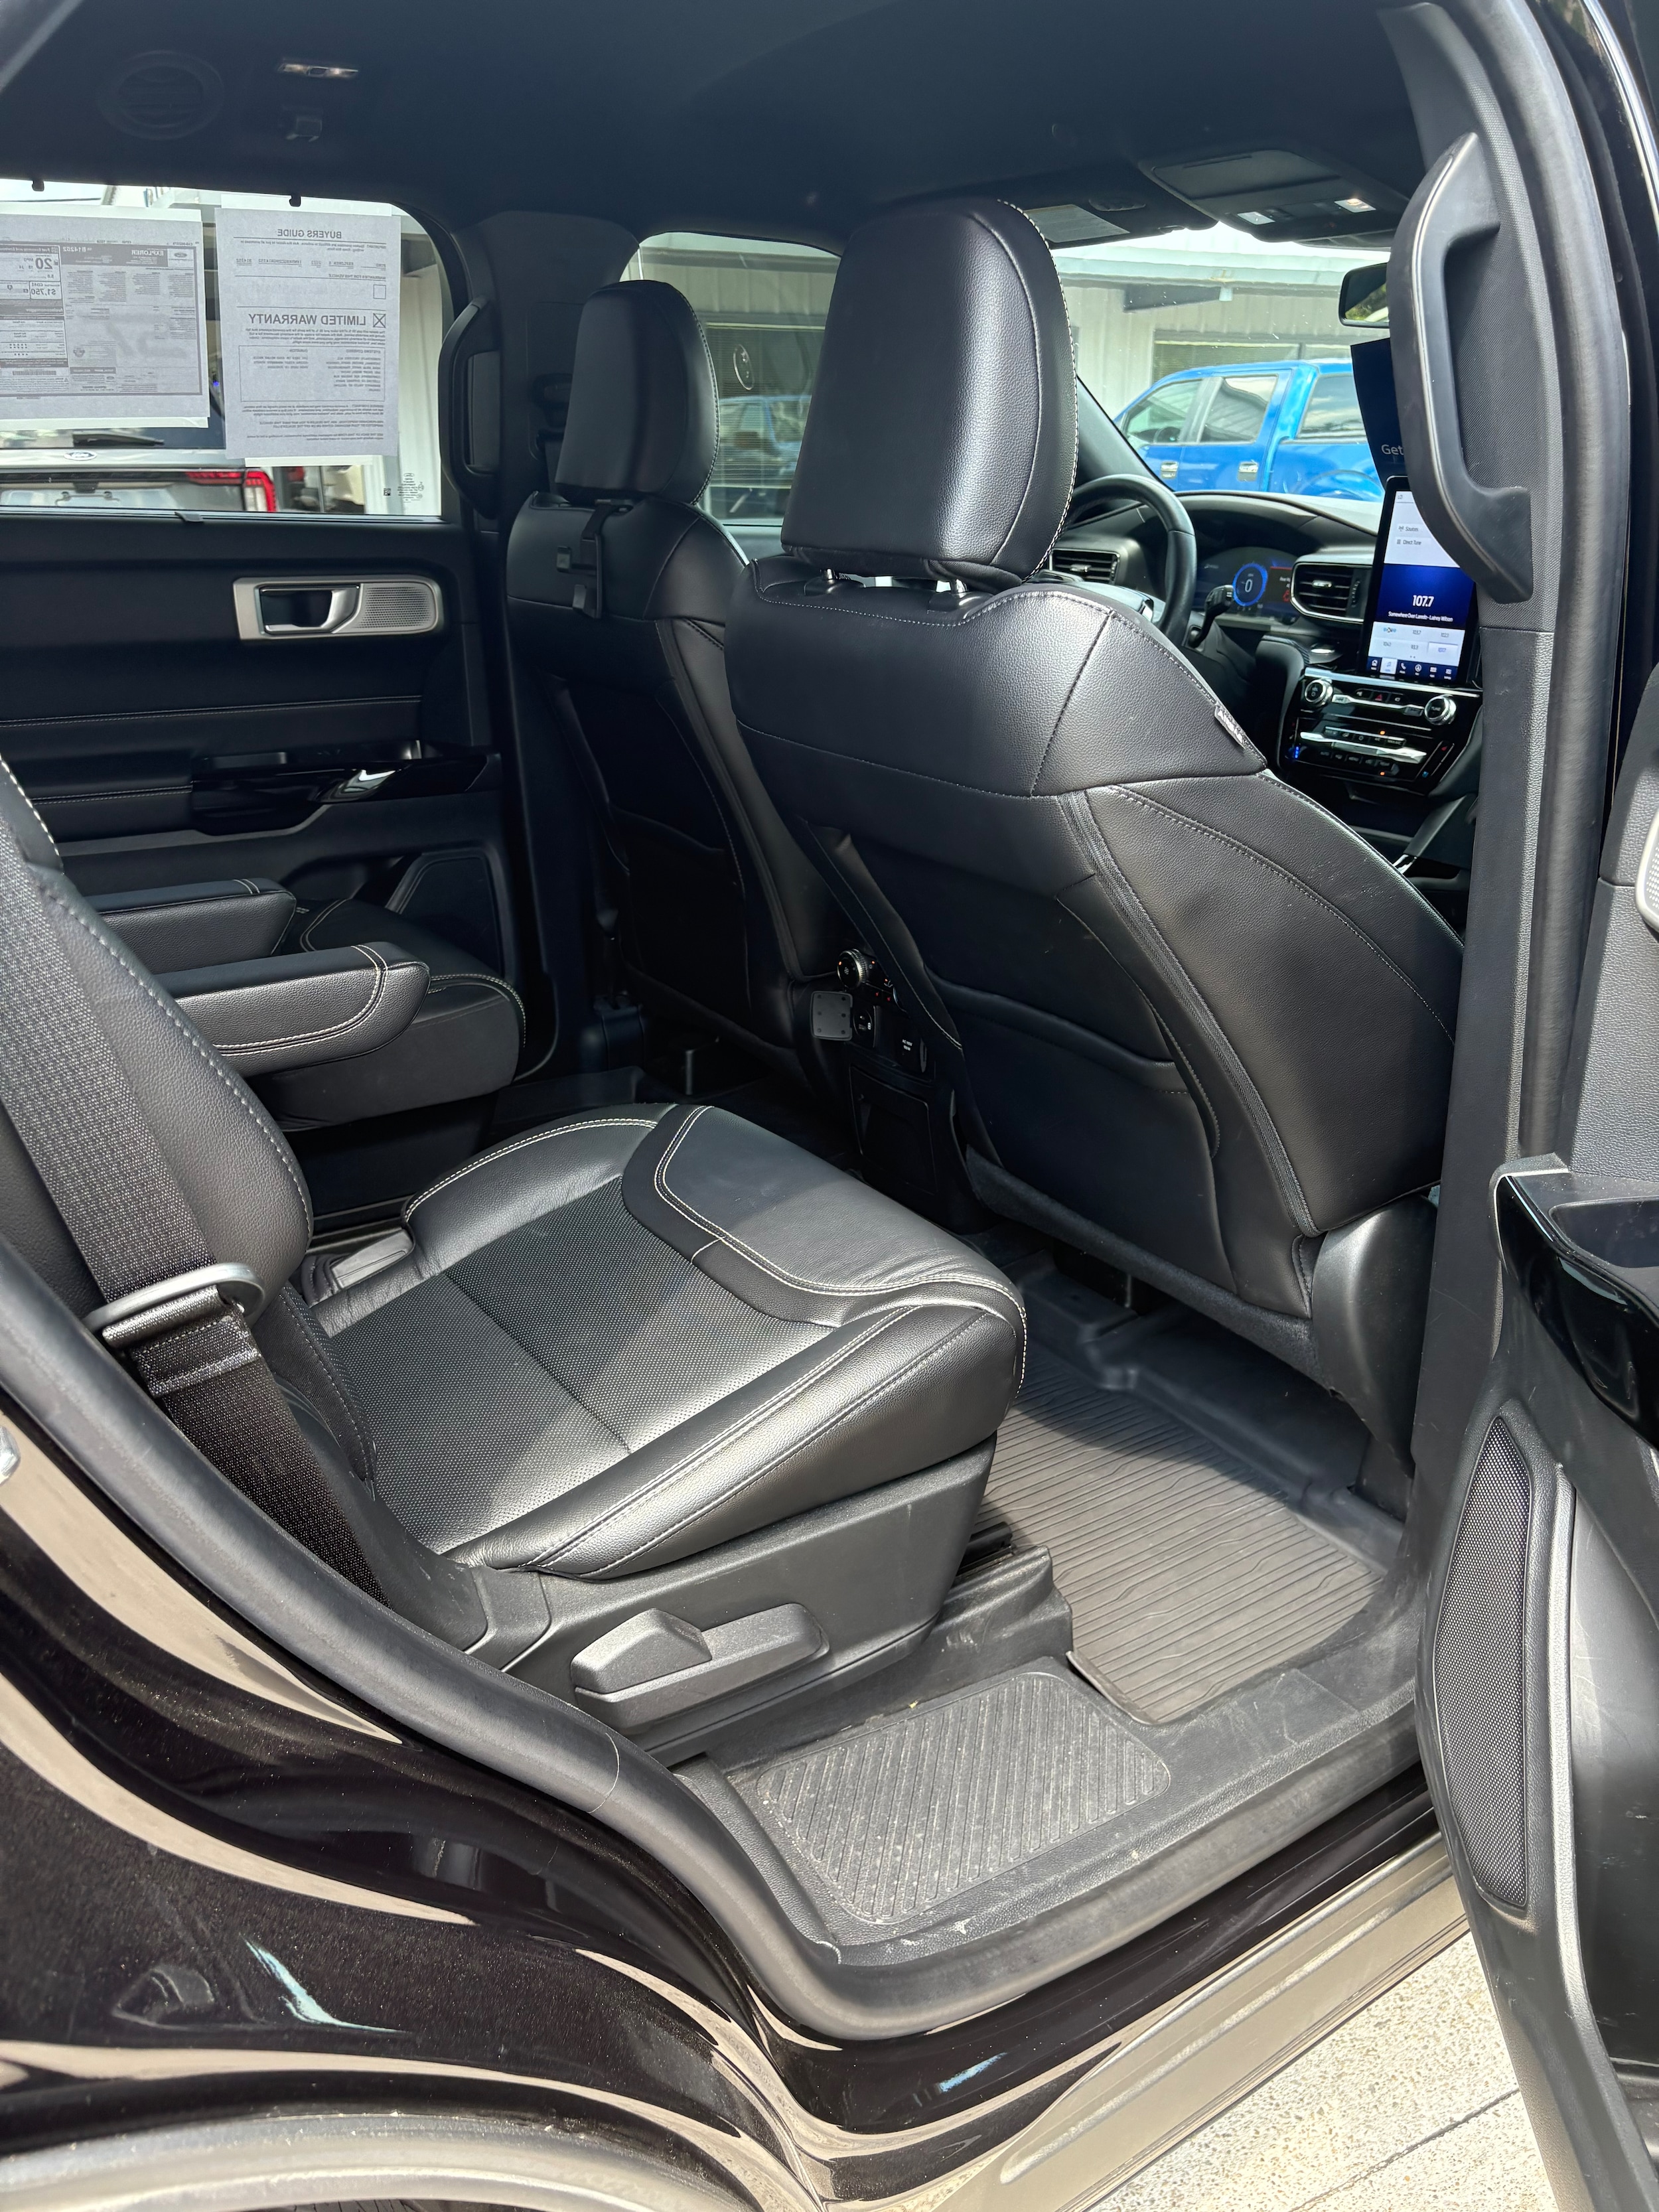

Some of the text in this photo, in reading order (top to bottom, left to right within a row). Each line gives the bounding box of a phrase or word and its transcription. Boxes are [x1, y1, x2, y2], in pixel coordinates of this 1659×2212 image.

[1382, 444, 1404, 455] Get
[1245, 579, 1252, 593] 0
[1412, 595, 1435, 607] 107.7
